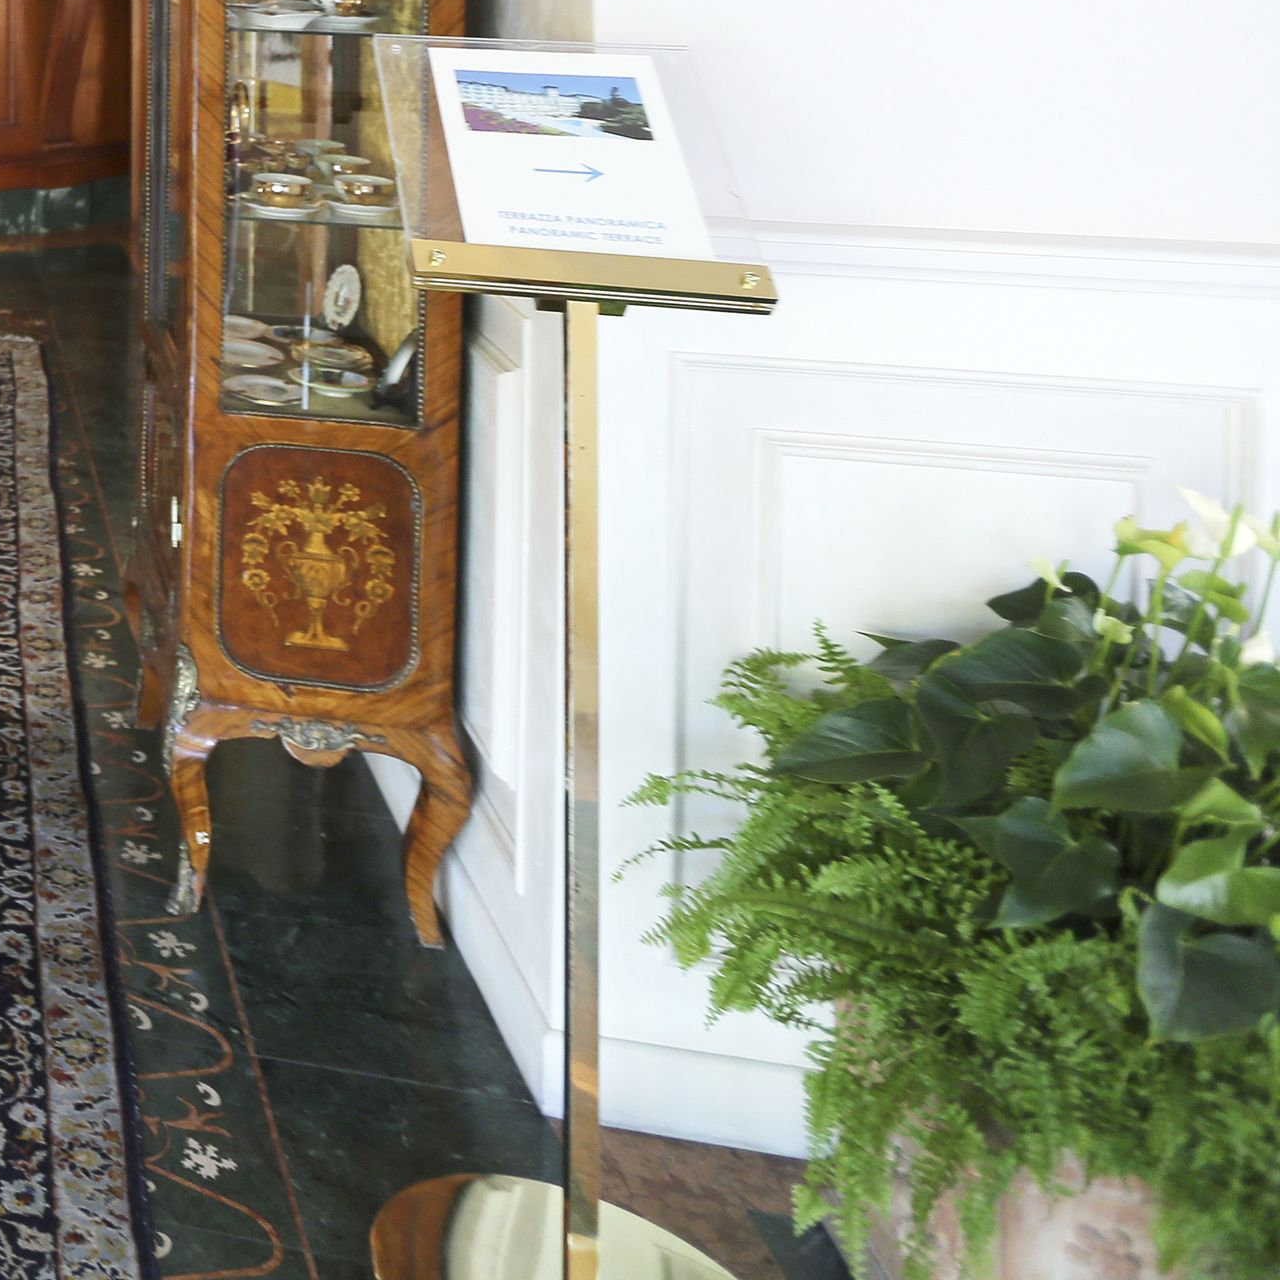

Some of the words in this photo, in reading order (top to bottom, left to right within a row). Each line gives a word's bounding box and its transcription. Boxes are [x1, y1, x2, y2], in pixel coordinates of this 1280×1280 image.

[497, 210, 562, 222] TERRAZZA
[566, 215, 668, 230] PANORAMICA
[509, 226, 598, 240] PANORAMIC
[601, 232, 664, 245] TERRACE
